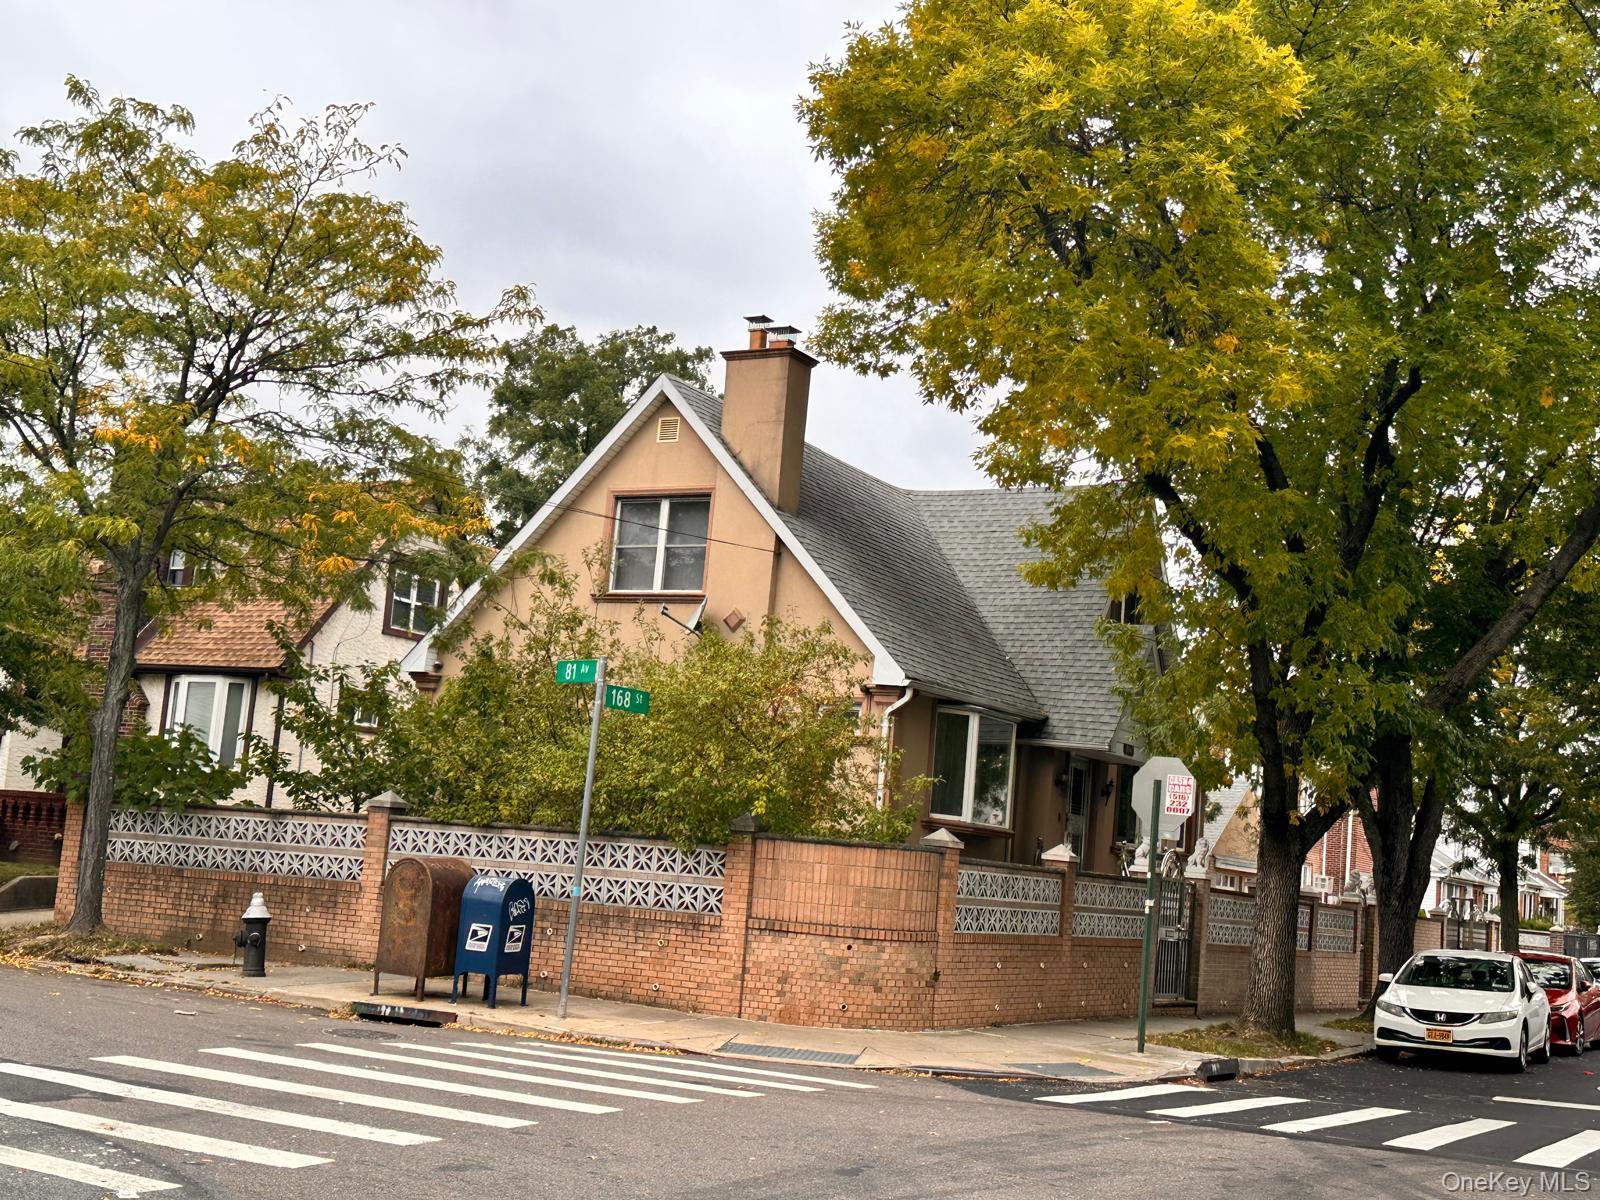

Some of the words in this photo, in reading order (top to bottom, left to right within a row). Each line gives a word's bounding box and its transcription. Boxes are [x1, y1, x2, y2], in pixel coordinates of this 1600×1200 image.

[565, 663, 577, 680] 81
[580, 663, 590, 674] Av
[611, 688, 631, 708] 168
[635, 693, 643, 704] St
[1166, 806, 1190, 815] 0007
[1169, 800, 1188, 808] 232
